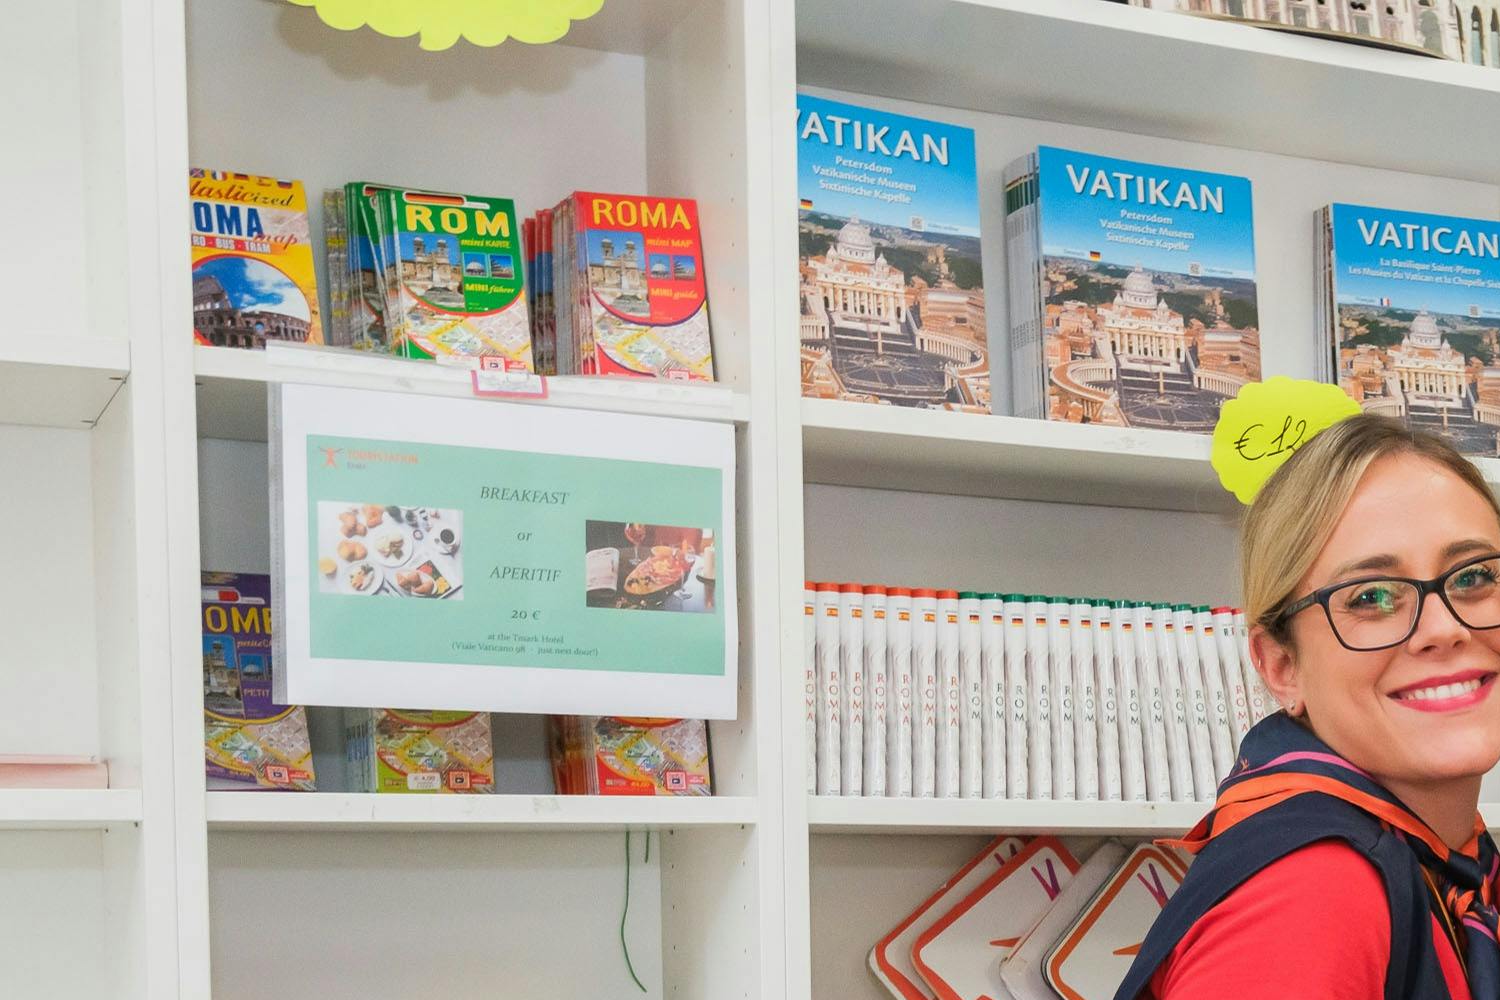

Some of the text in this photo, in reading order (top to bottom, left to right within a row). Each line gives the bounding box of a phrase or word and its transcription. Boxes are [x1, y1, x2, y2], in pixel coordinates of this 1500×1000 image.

[835, 155, 893, 174] Petersdom
[812, 165, 917, 192] Vatikanische Museen
[1066, 164, 1224, 213] VATIKAN
[190, 180, 294, 206] lasticized
[873, 189, 912, 205] Kapelle
[193, 201, 264, 238] OMA
[405, 204, 510, 238] ROM
[592, 198, 692, 231] ROMA
[1120, 208, 1173, 225] Petersdom
[1100, 219, 1195, 240] Vatikanische Museen
[1357, 218, 1500, 259] VATICAN
[1155, 240, 1190, 252] Kapelle
[480, 486, 570, 506] BREAKFAST
[517, 531, 532, 543] or
[489, 566, 562, 583] APERITIF
[511, 610, 528, 620] 20
